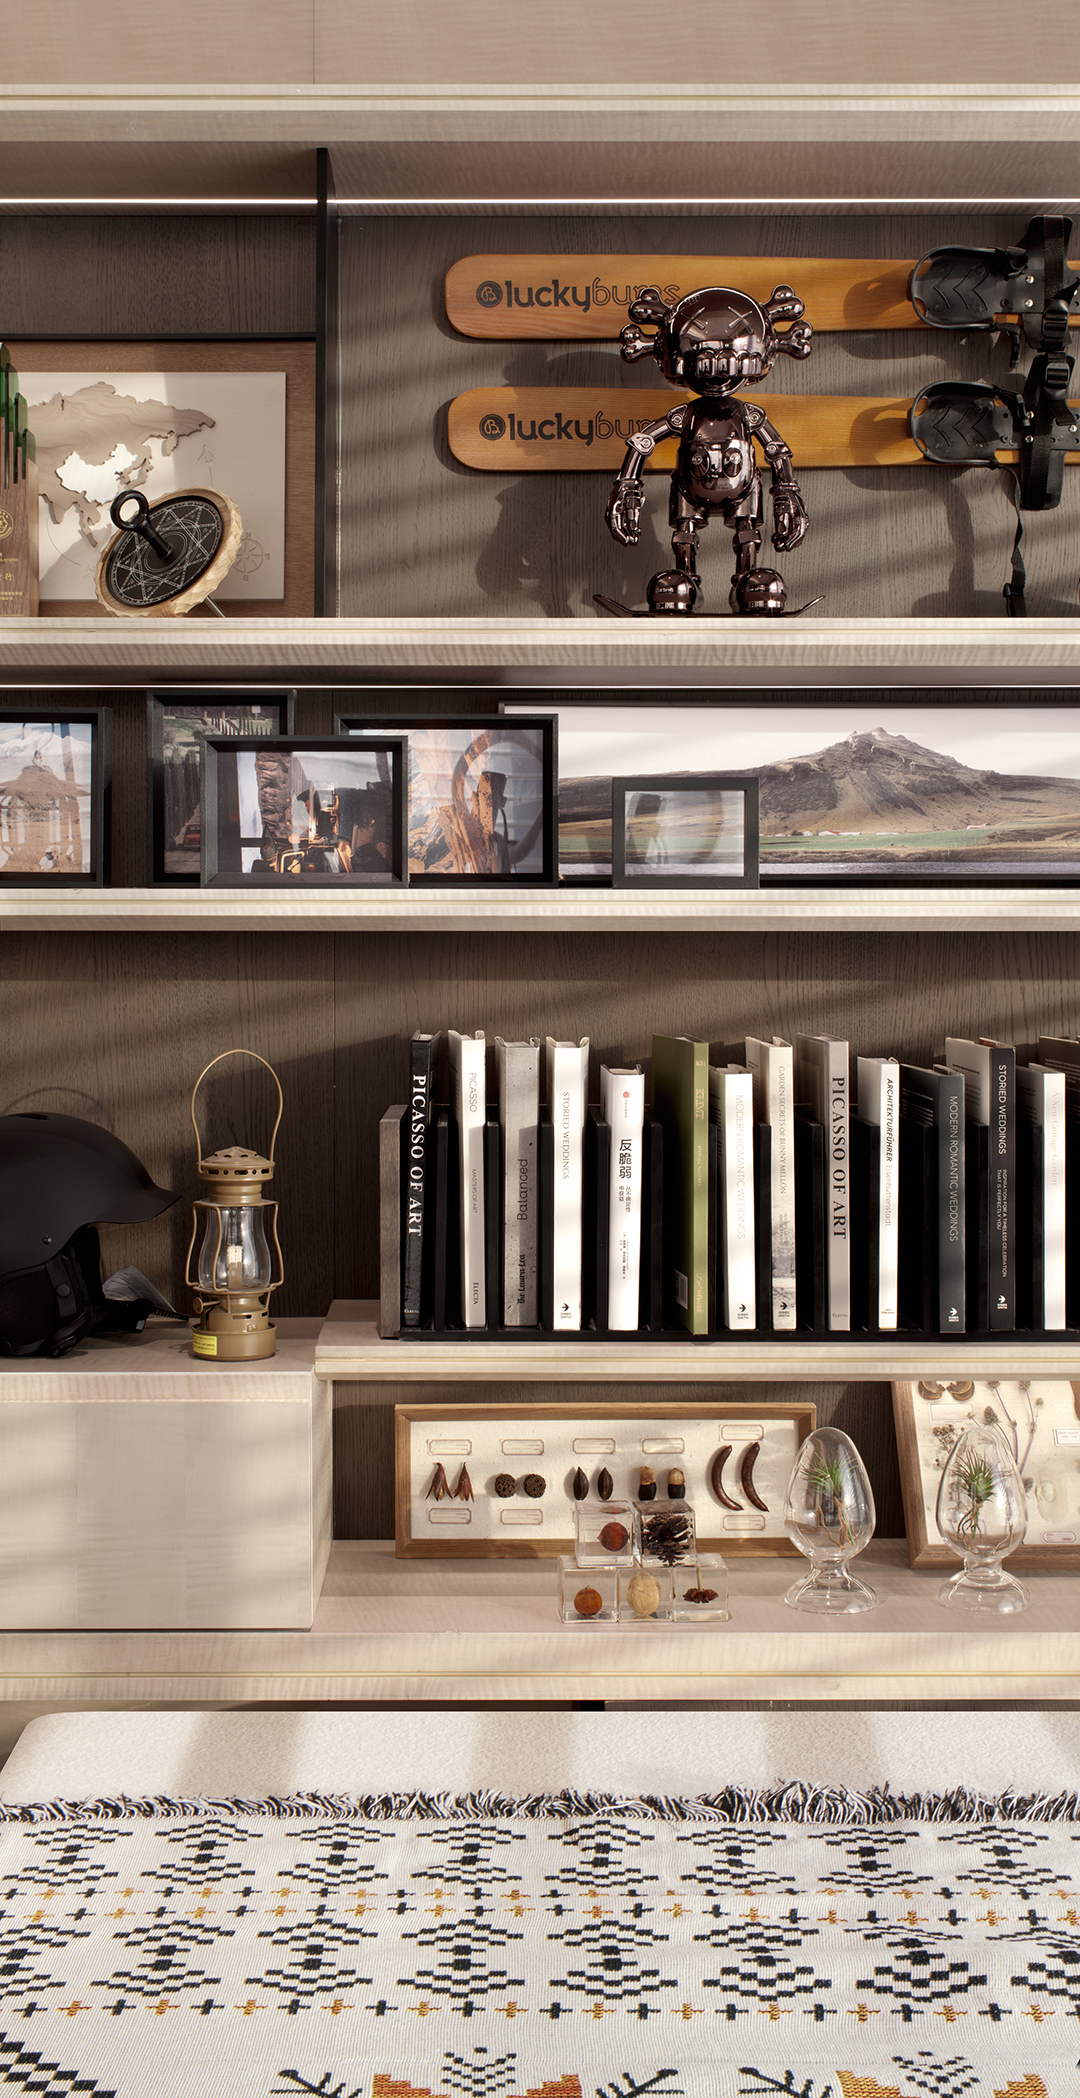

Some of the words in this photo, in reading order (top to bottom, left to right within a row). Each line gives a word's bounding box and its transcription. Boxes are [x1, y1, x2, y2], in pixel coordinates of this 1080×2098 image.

[507, 411, 681, 446] luckybu
[468, 1072, 478, 1113] PICASSO
[778, 1066, 786, 1096] GARDEN
[998, 1064, 1007, 1103] STORIED
[411, 1074, 427, 1160] PICASSO
[562, 1091, 570, 1129] STORIED
[696, 1088, 705, 1119] KLIMT
[735, 1094, 745, 1136] MODERN
[832, 1076, 845, 1161] PICASSO
[886, 1078, 894, 1162] ARCHITEKTURFÜHRER
[949, 1096, 959, 1138] MODERN
[1052, 1100, 1060, 1117] New
[779, 1127, 786, 1136] OF
[998, 1104, 1007, 1155] WEDDINGS
[1049, 1120, 1060, 1152] Cottage
[562, 1131, 570, 1180] WEDDINGS
[618, 1139, 632, 1179] 反脆弱
[736, 1138, 745, 1187] ROMANTIC
[779, 1137, 787, 1164] BUNNY
[949, 1140, 959, 1189] ROMANTIC
[1051, 1154, 1060, 1186] Garden
[409, 1166, 424, 1191] OF
[517, 1158, 528, 1222] Balanced
[832, 1168, 846, 1194] OF
[885, 1165, 893, 1227] Eisenhüttenstadt
[409, 1197, 424, 1236] ART
[737, 1188, 746, 1239] WEDDINGS
[833, 1200, 847, 1240] ART
[949, 1190, 959, 1242] WEDDINGS
